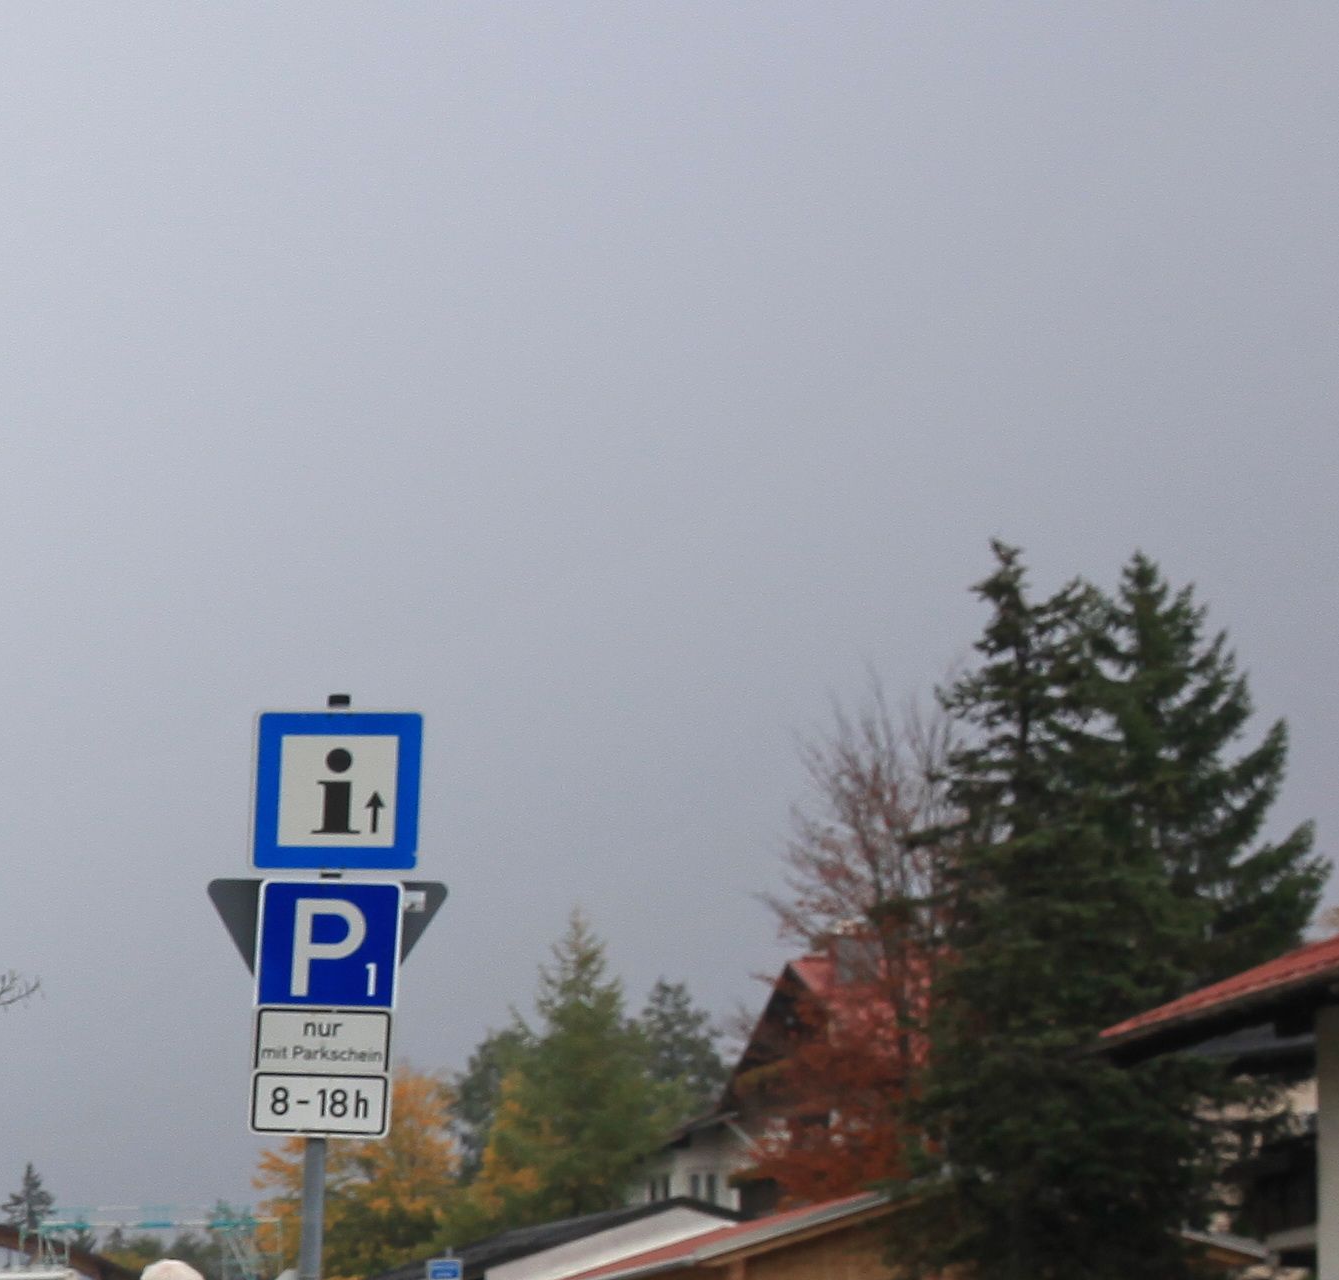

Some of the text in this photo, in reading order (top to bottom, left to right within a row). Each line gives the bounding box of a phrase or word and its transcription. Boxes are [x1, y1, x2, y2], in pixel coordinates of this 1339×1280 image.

[289, 897, 378, 998] P 1
[303, 1022, 343, 1038] nur
[261, 1046, 383, 1062] mit Parkschein
